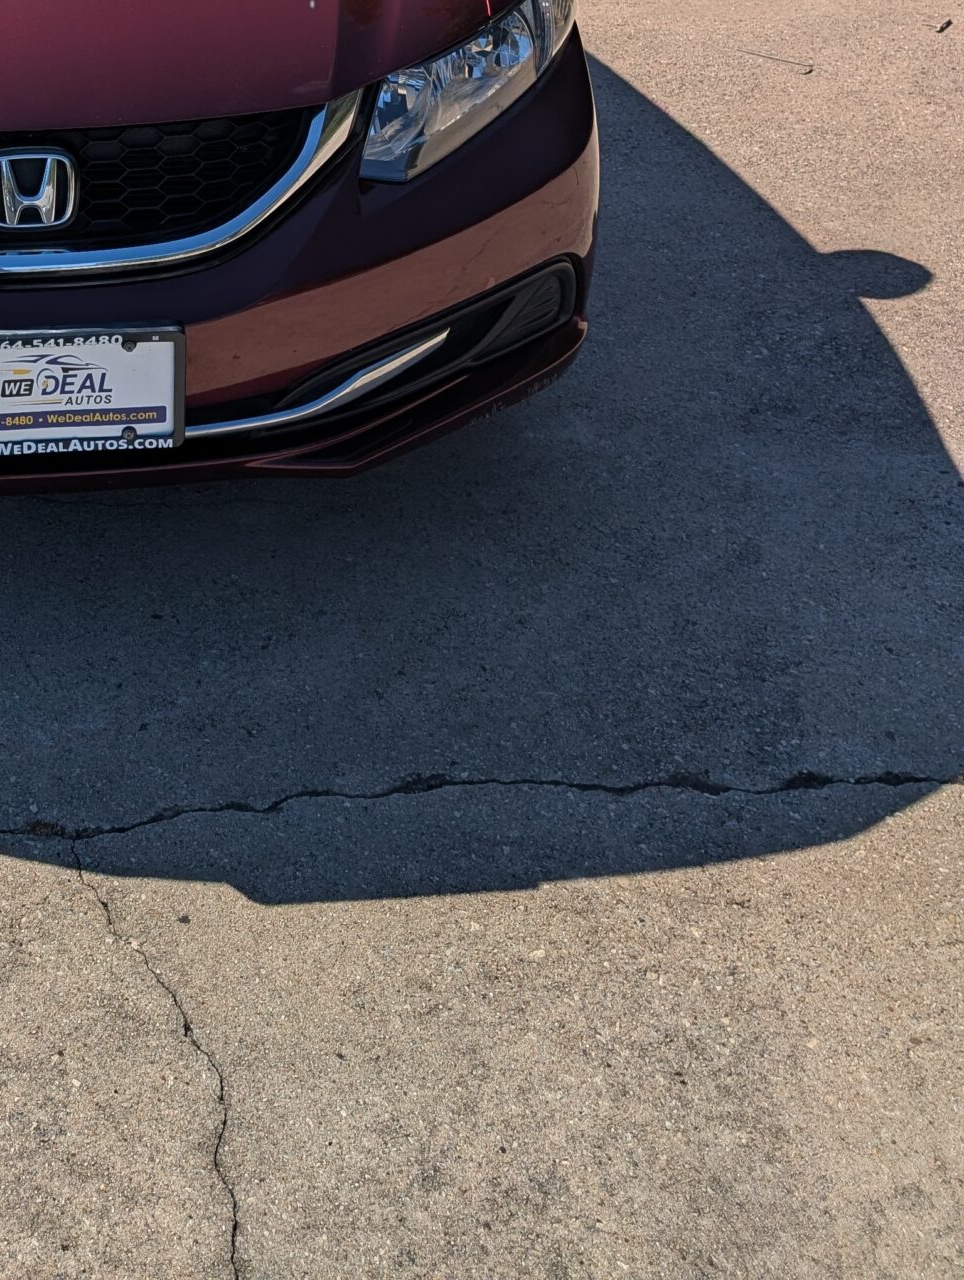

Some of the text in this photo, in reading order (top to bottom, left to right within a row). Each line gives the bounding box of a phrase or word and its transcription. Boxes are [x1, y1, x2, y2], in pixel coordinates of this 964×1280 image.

[4, 372, 113, 396] WE DEAL
[65, 394, 112, 406] AUTOS
[46, 410, 157, 424] WeDealAutos.com
